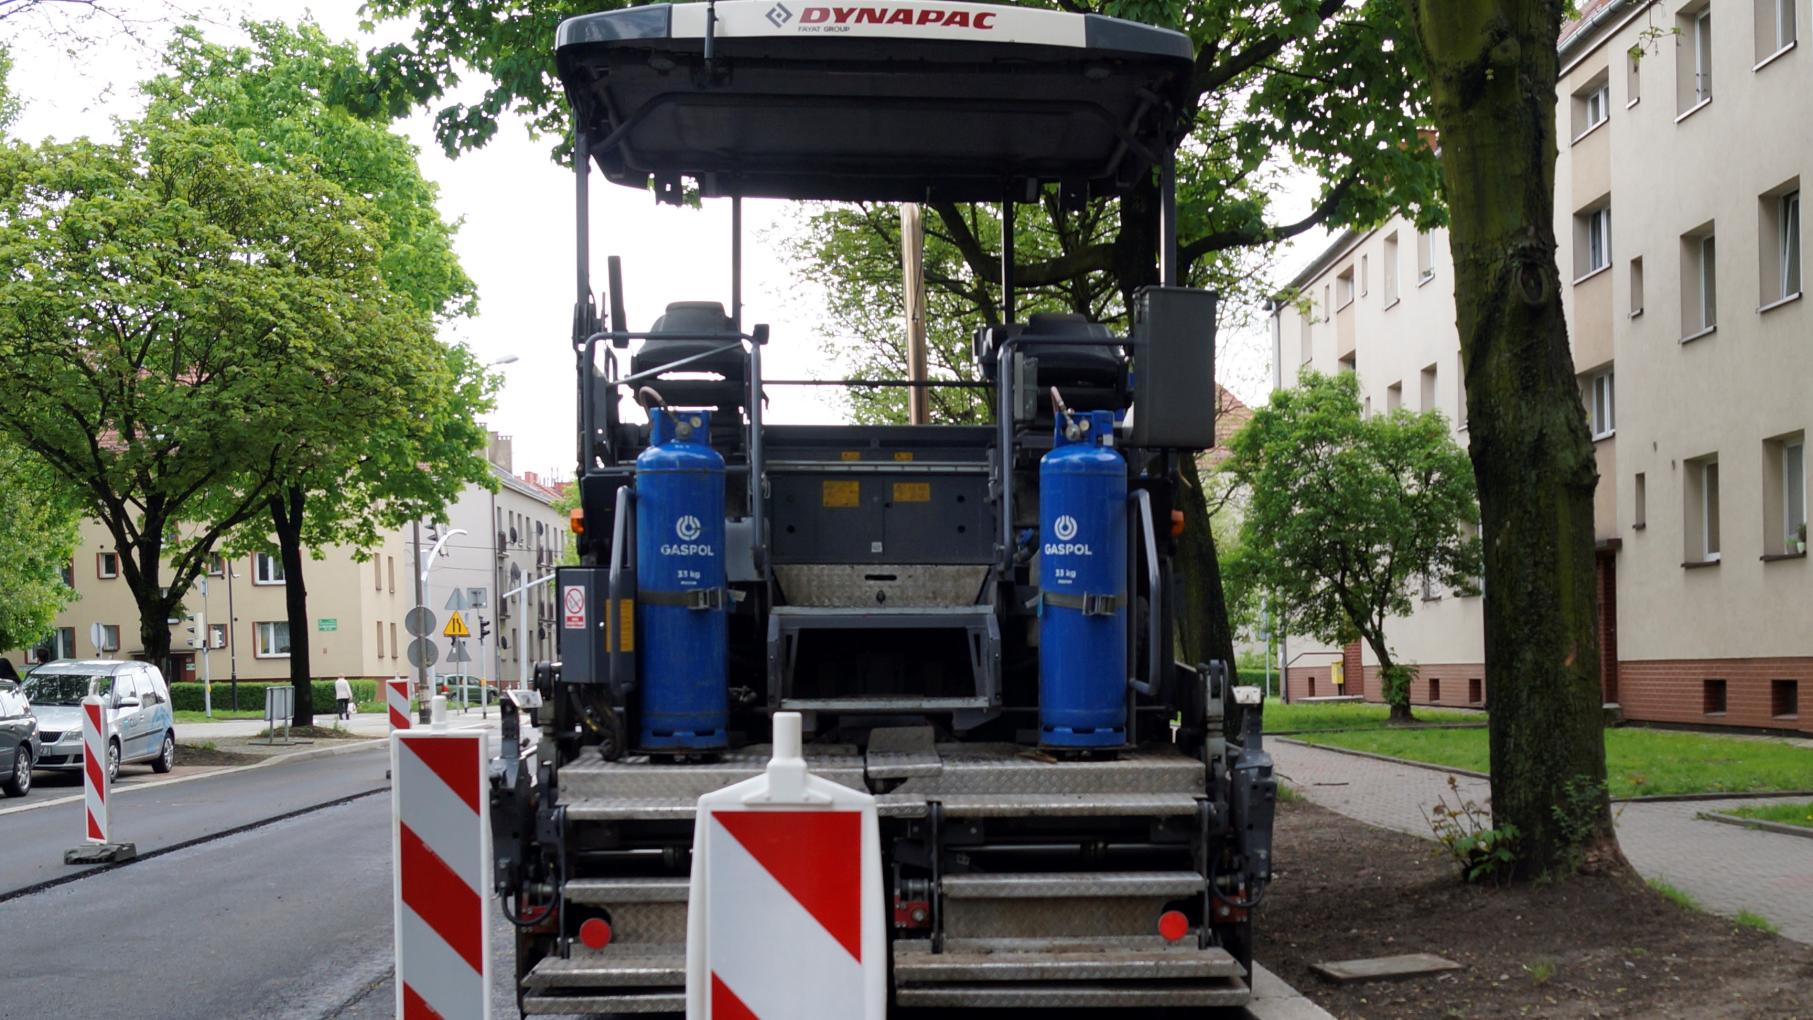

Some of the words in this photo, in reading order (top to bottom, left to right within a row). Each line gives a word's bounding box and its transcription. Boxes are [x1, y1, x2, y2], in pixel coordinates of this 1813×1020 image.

[799, 7, 997, 30] DYNAPAC
[660, 544, 714, 556] GASPOL
[1044, 543, 1092, 555] GASPOL
